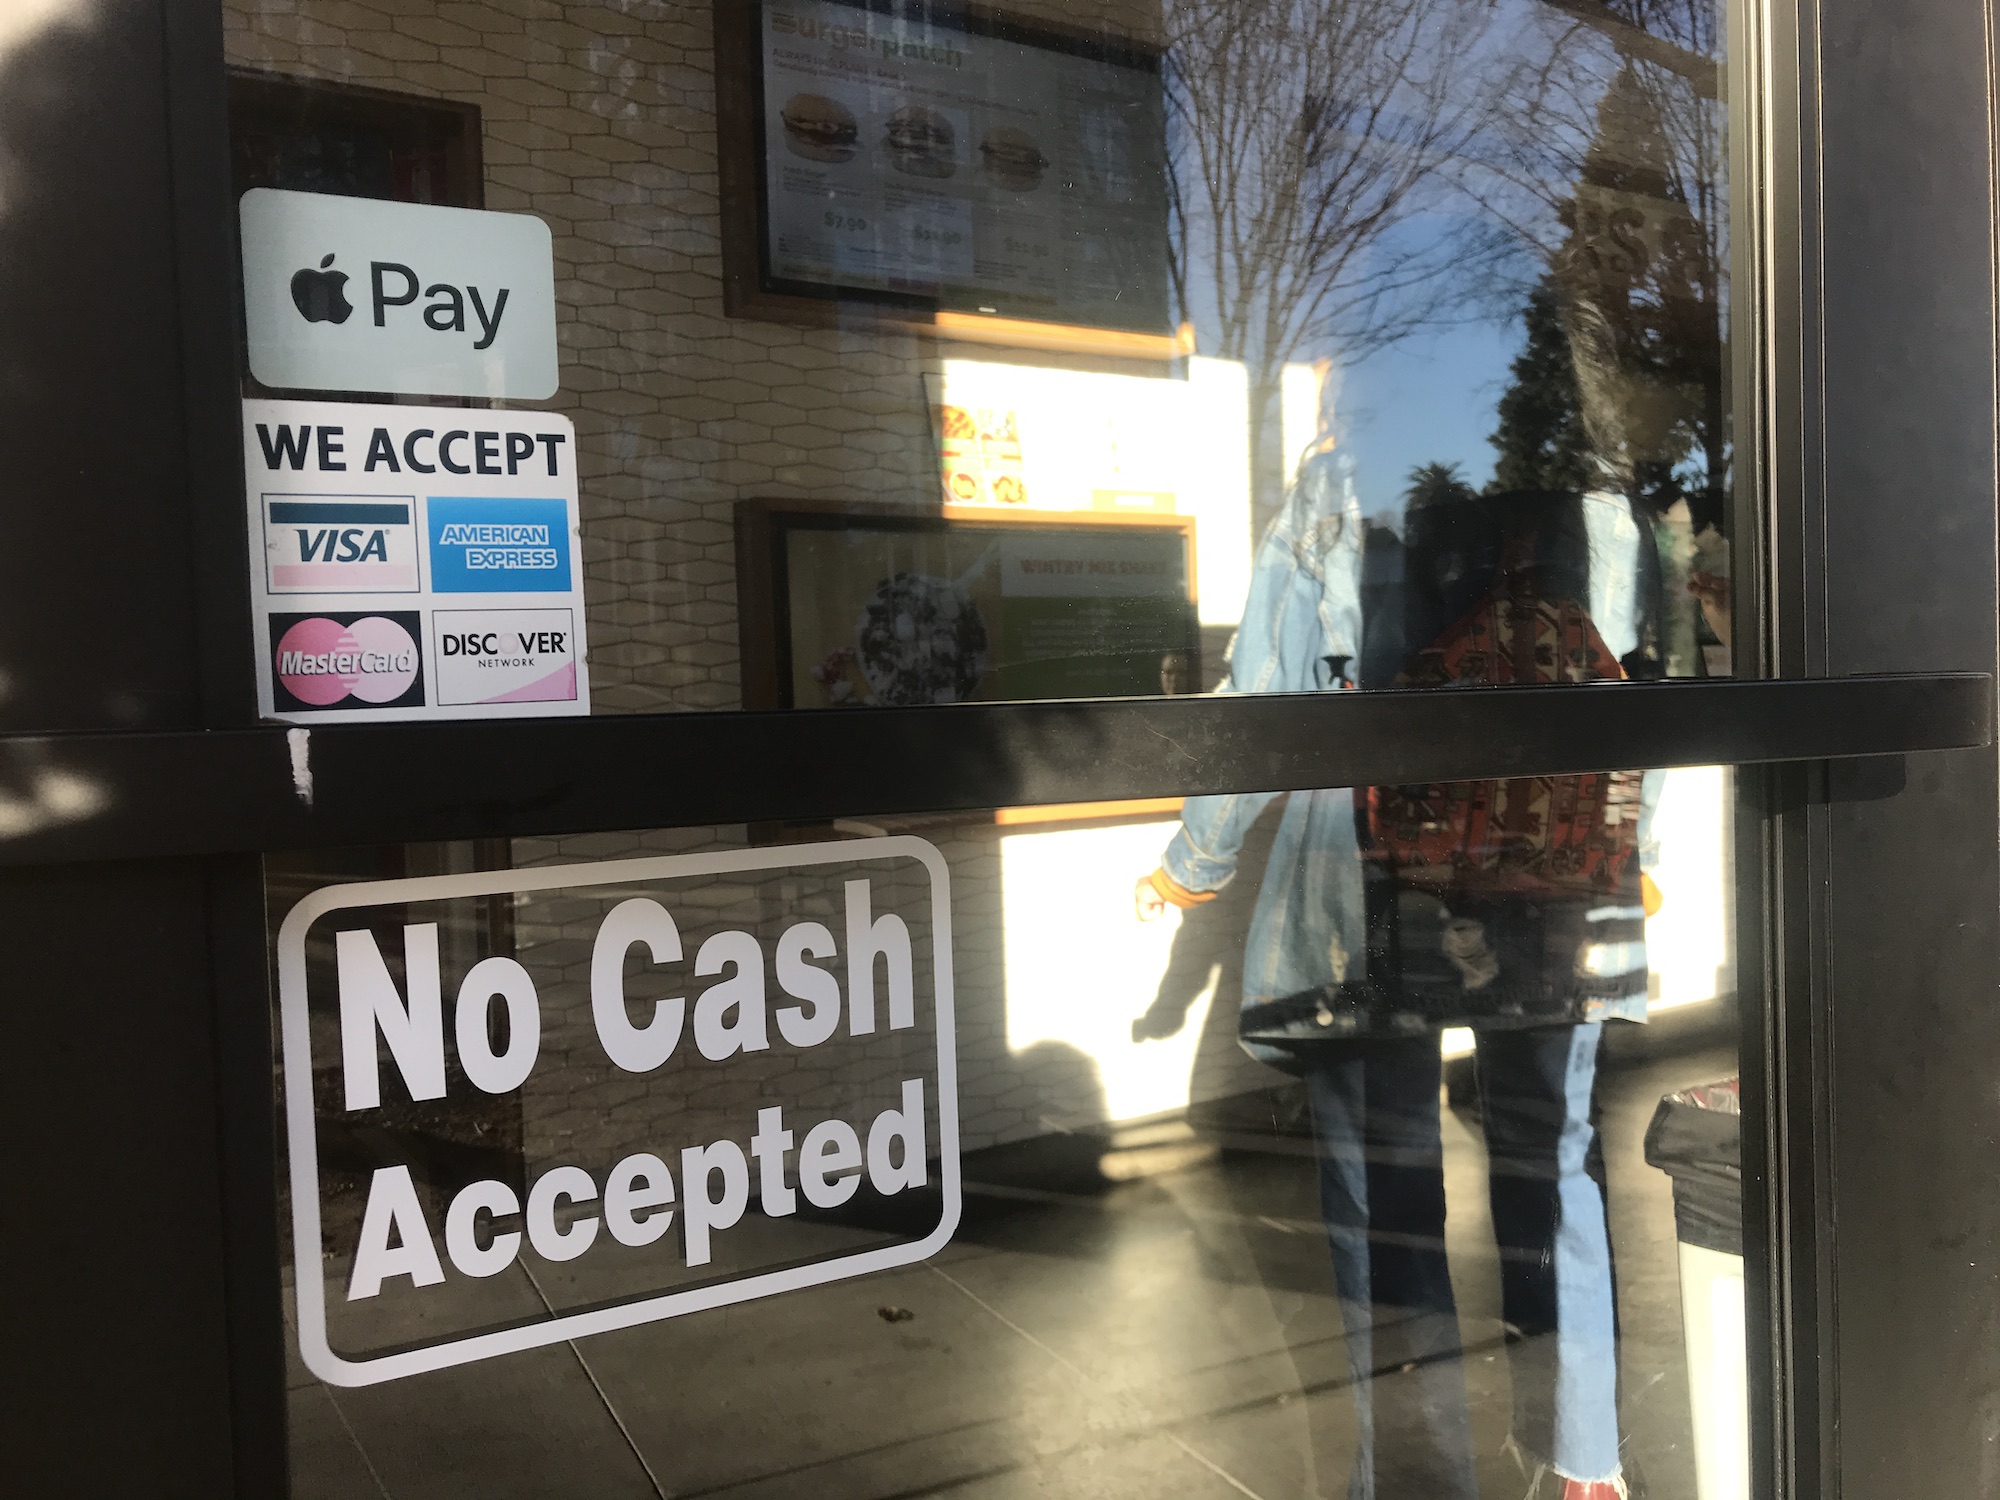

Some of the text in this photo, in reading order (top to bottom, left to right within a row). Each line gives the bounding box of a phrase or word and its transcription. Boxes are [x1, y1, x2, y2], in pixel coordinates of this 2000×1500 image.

[370, 261, 510, 350] Pay
[255, 423, 566, 477] WE ACCEPT
[293, 528, 389, 563] VISA
[440, 524, 549, 545] AMERICAN
[466, 548, 559, 570] EXPRESS
[442, 632, 567, 656] DISCOVER
[279, 649, 413, 676] MasterCard
[478, 657, 535, 668] NETWORK
[335, 878, 916, 1112] No Cash
[347, 1078, 929, 1302] Accepted
